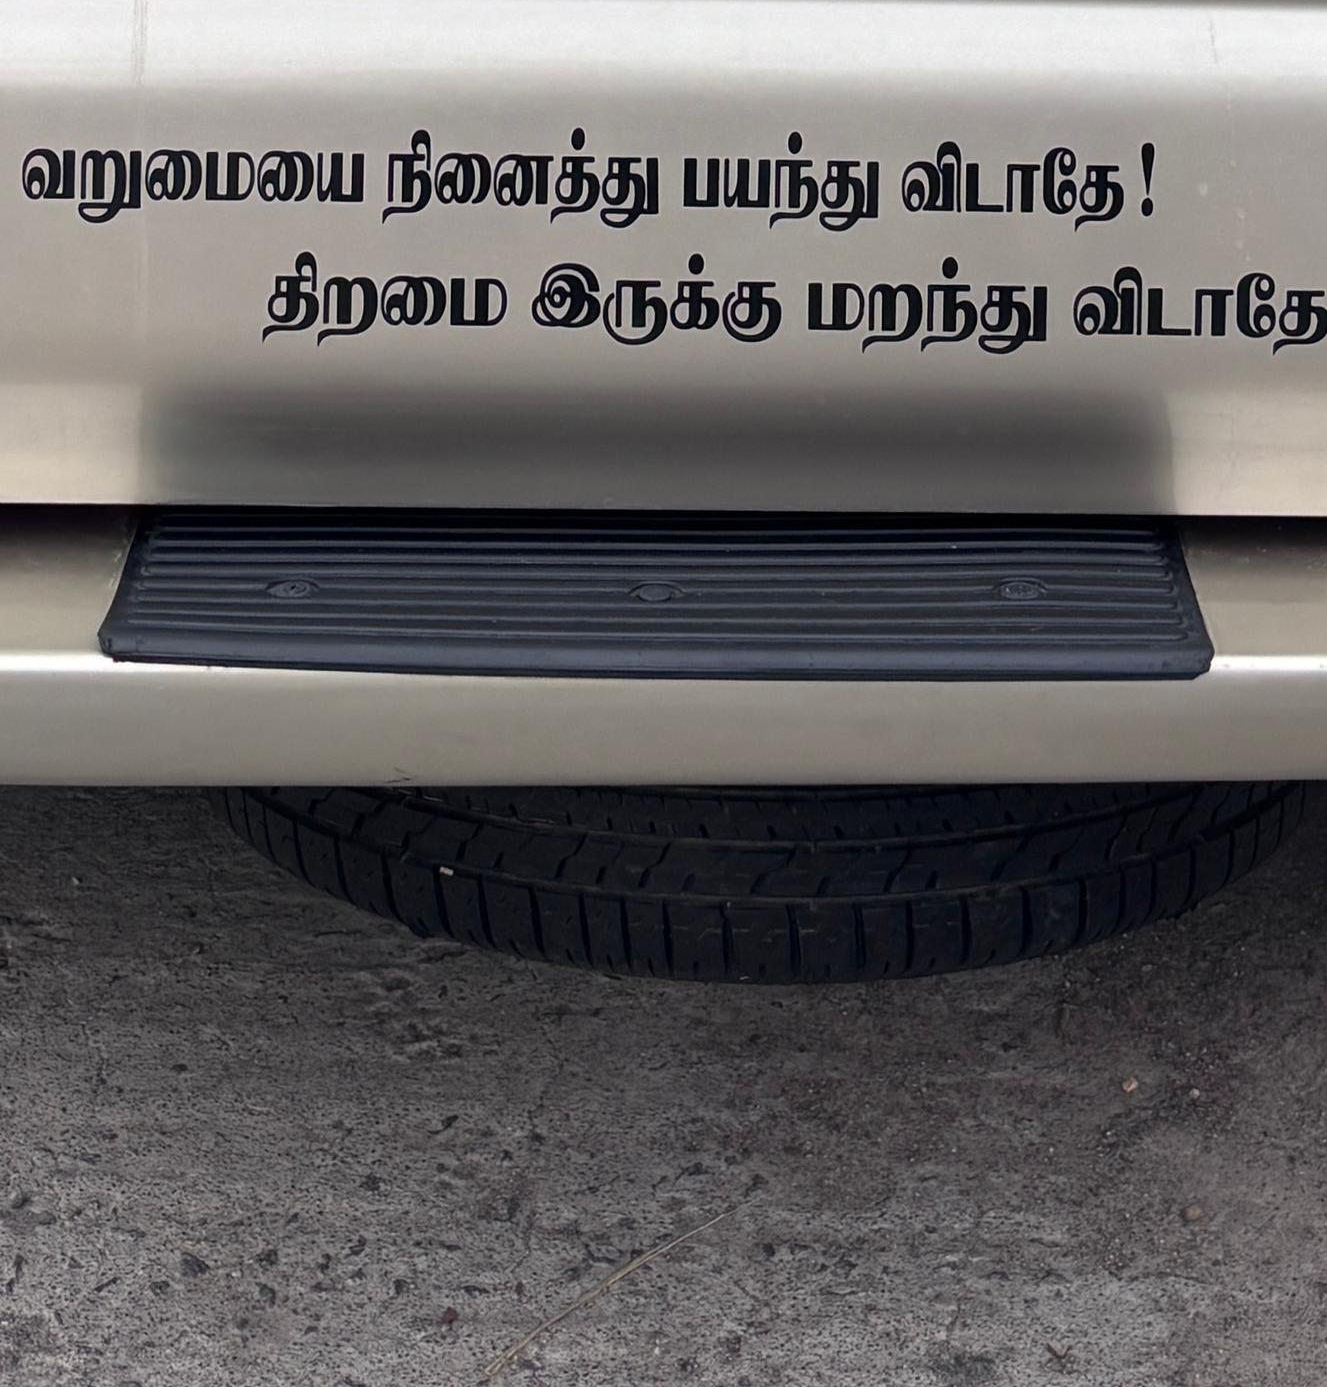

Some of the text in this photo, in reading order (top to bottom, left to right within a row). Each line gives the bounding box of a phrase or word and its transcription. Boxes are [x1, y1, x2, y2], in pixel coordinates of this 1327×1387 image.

[22, 148, 365, 224] வறுமையை
[381, 127, 659, 229] நினைத்து
[683, 131, 880, 232] பயந்து
[262, 251, 508, 347] திறமை
[531, 253, 783, 346] இருக்கு
[807, 256, 1048, 355] மறந்து
